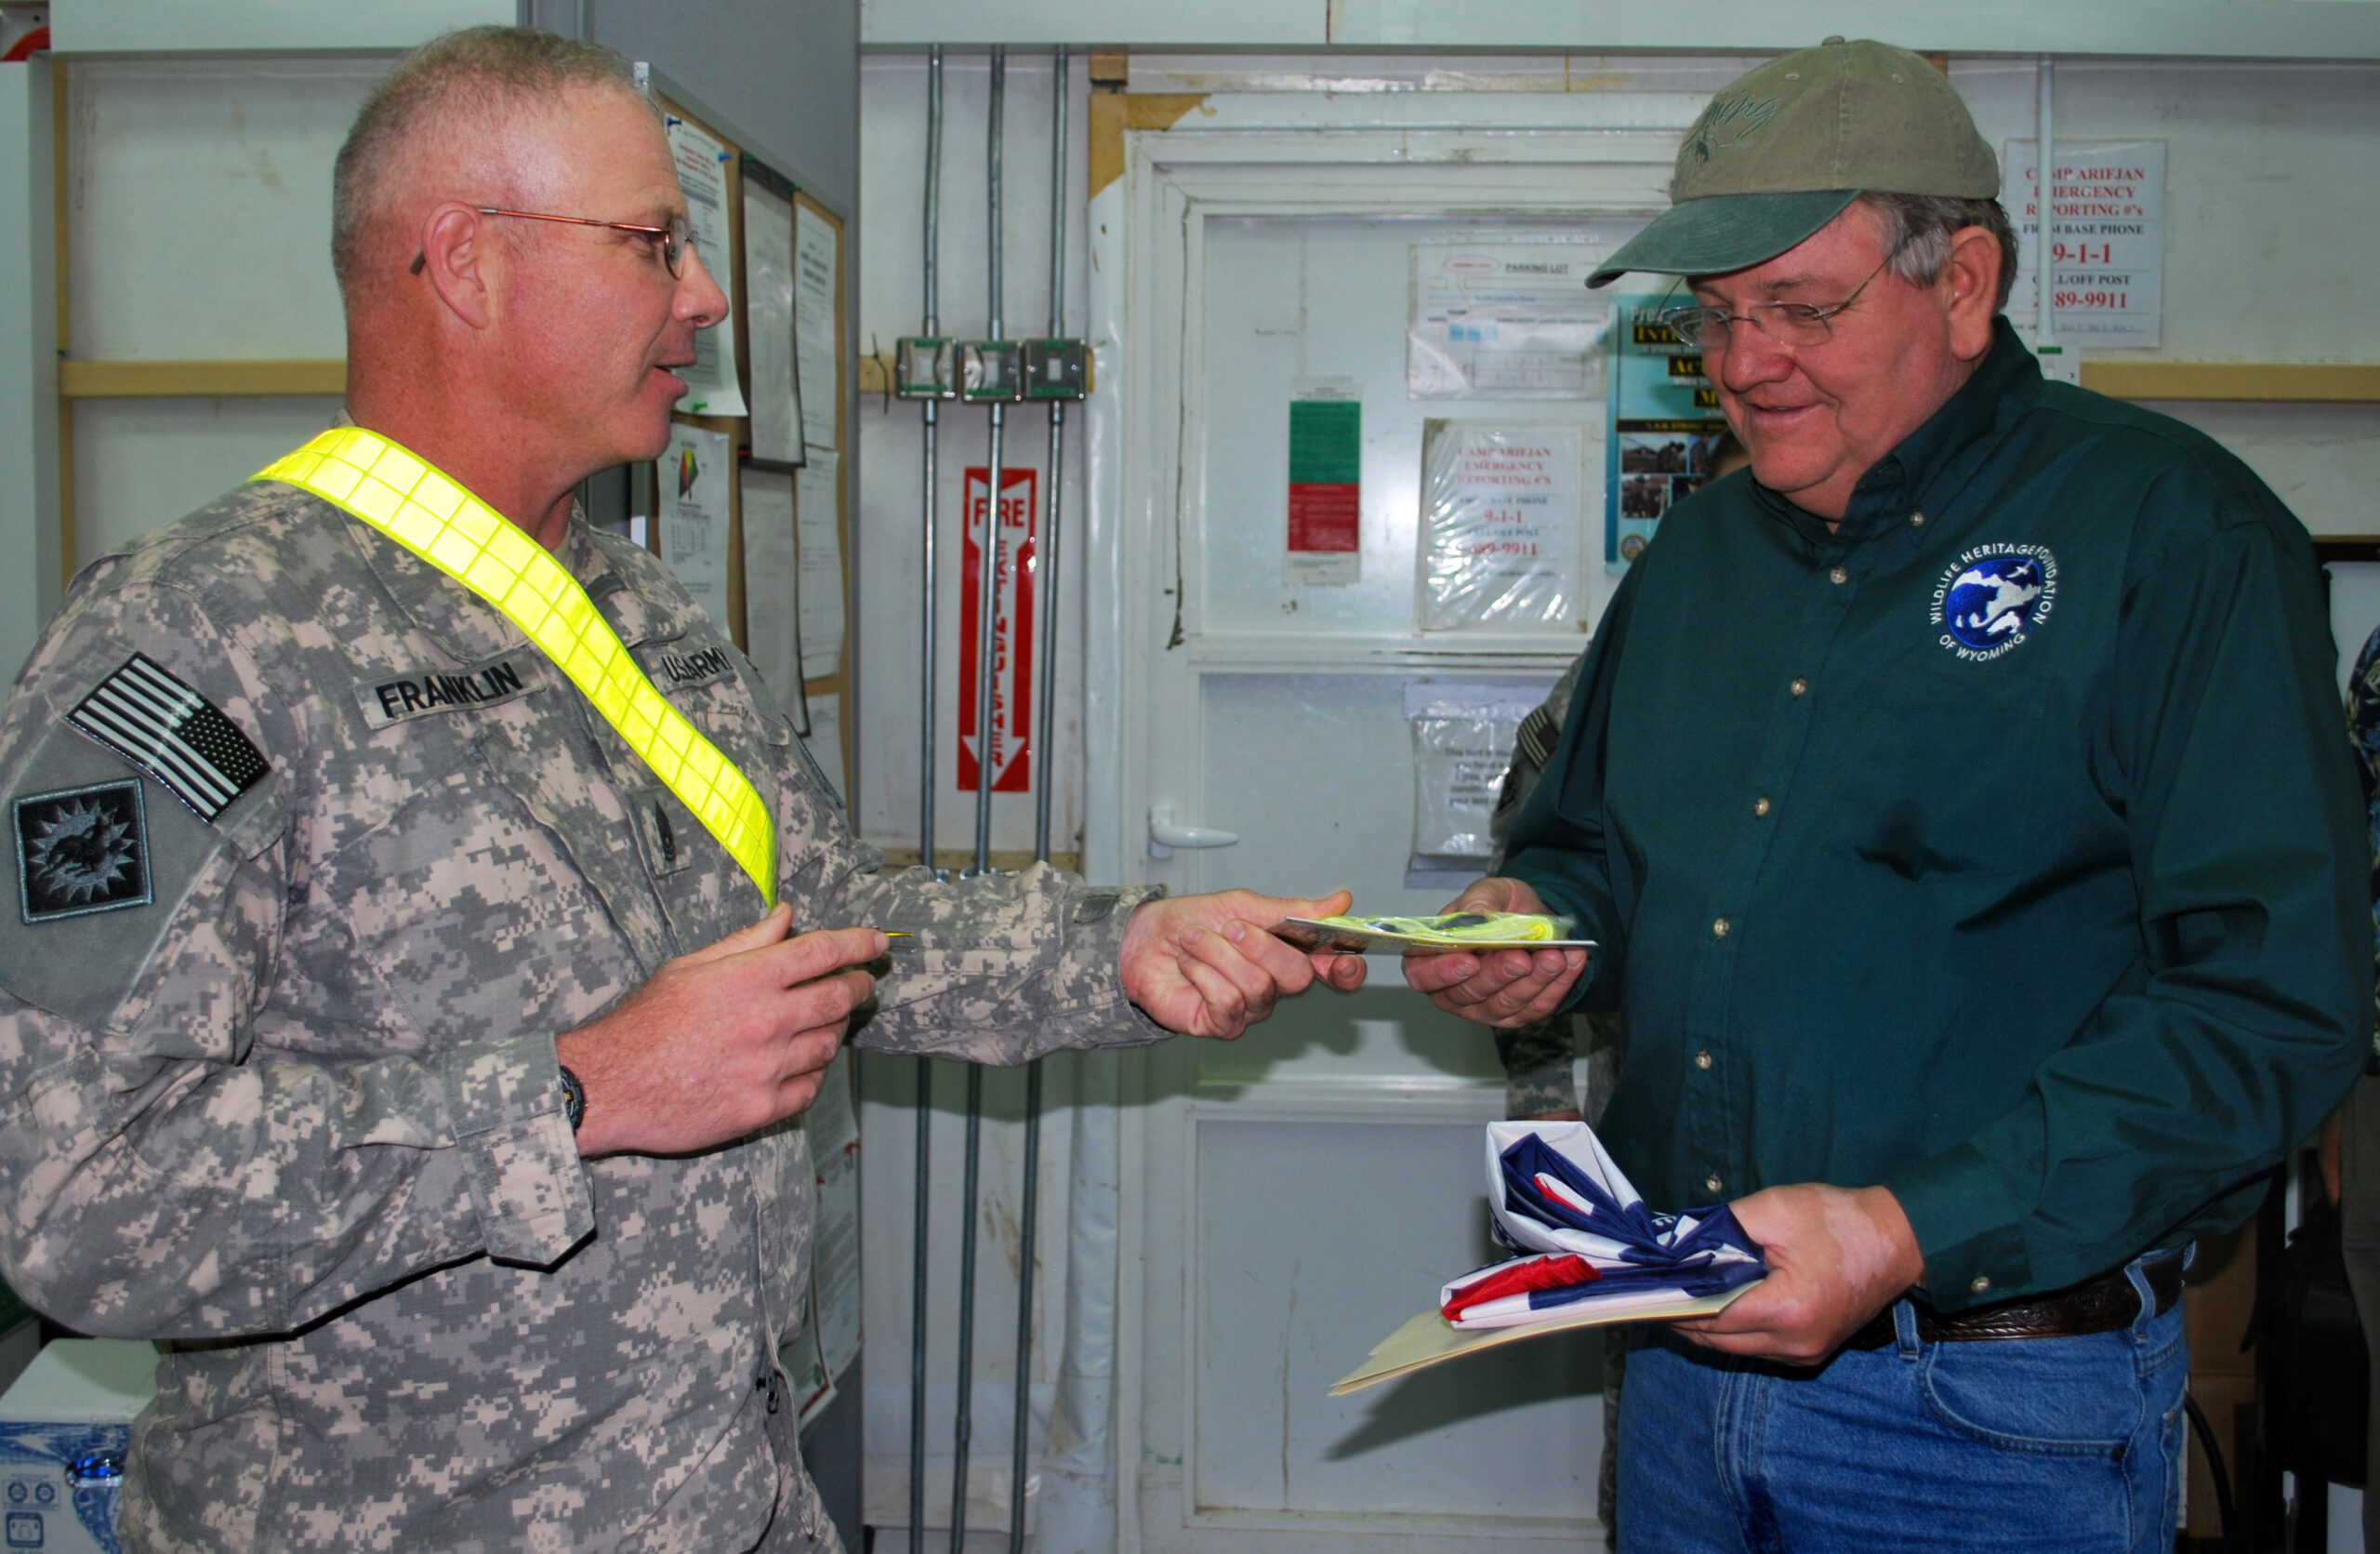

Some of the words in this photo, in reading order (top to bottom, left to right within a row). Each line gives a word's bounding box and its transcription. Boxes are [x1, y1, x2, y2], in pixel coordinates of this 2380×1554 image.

[2026, 168, 2072, 180] CMP
[2076, 168, 2146, 180] ARIFJAN
[2026, 204, 2120, 216] RORTING
[2023, 224, 2060, 234] FRM
[2065, 224, 2096, 234] BASE
[2100, 224, 2144, 235] PHONE
[2052, 243, 2111, 263] 9-1-1
[1505, 263, 1548, 272] PARKING
[1551, 264, 1568, 272] LOT
[2032, 274, 2095, 285] CL/OFF
[2098, 275, 2131, 285] POST
[2033, 291, 2127, 308] 289-9911
[1464, 461, 1544, 471] EMERGENCY
[1458, 475, 1530, 485] REPORTING
[974, 498, 1025, 527] FRE
[1484, 510, 1522, 524] 9-1-1
[1930, 562, 1962, 625] WILDLIFE
[1961, 543, 2036, 563] HERITAGE
[2032, 546, 2059, 625] FOUNDATION
[1939, 634, 1956, 649] OF
[1956, 633, 2026, 661] WYOMING
[376, 661, 523, 718] FRANKLIN
